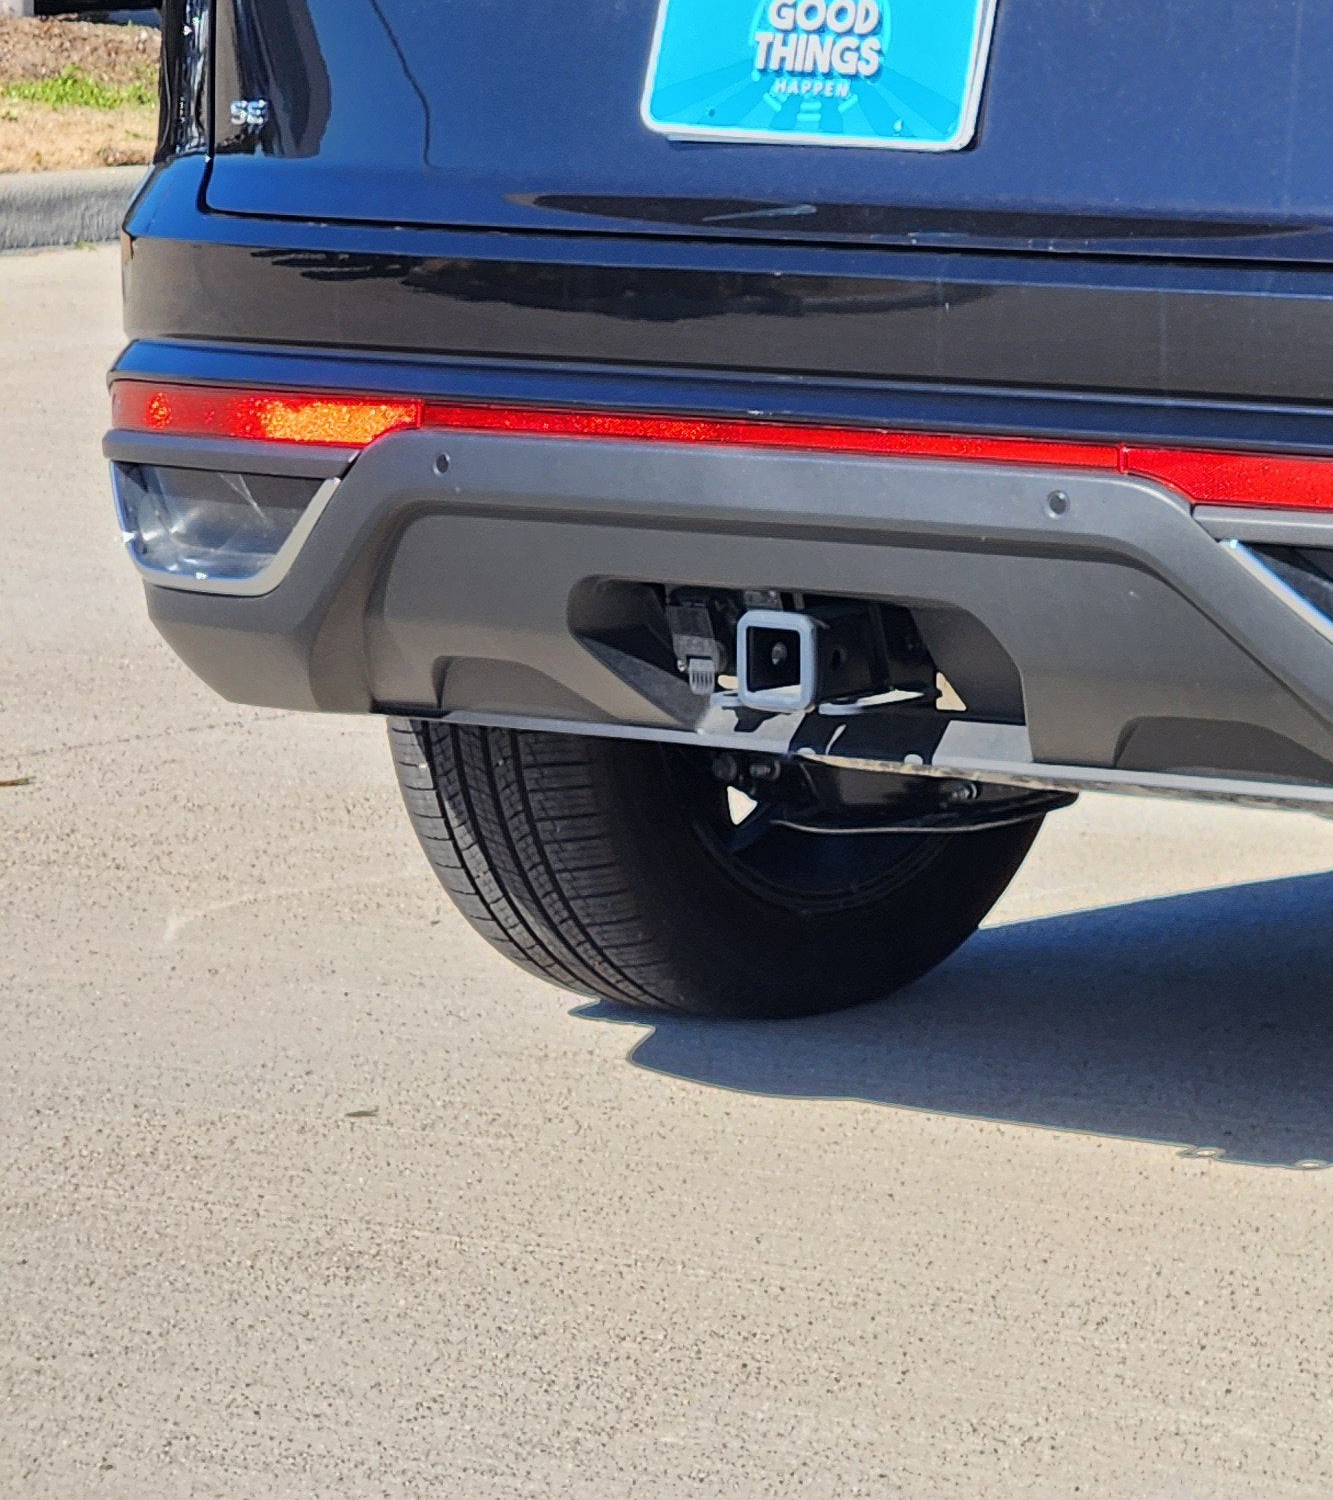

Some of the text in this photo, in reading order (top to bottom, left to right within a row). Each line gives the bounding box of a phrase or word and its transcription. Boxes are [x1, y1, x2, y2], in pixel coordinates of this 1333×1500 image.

[755, 31, 882, 77] THINGS
[774, 78, 851, 98] HAPPEN
[230, 99, 270, 125] SE
